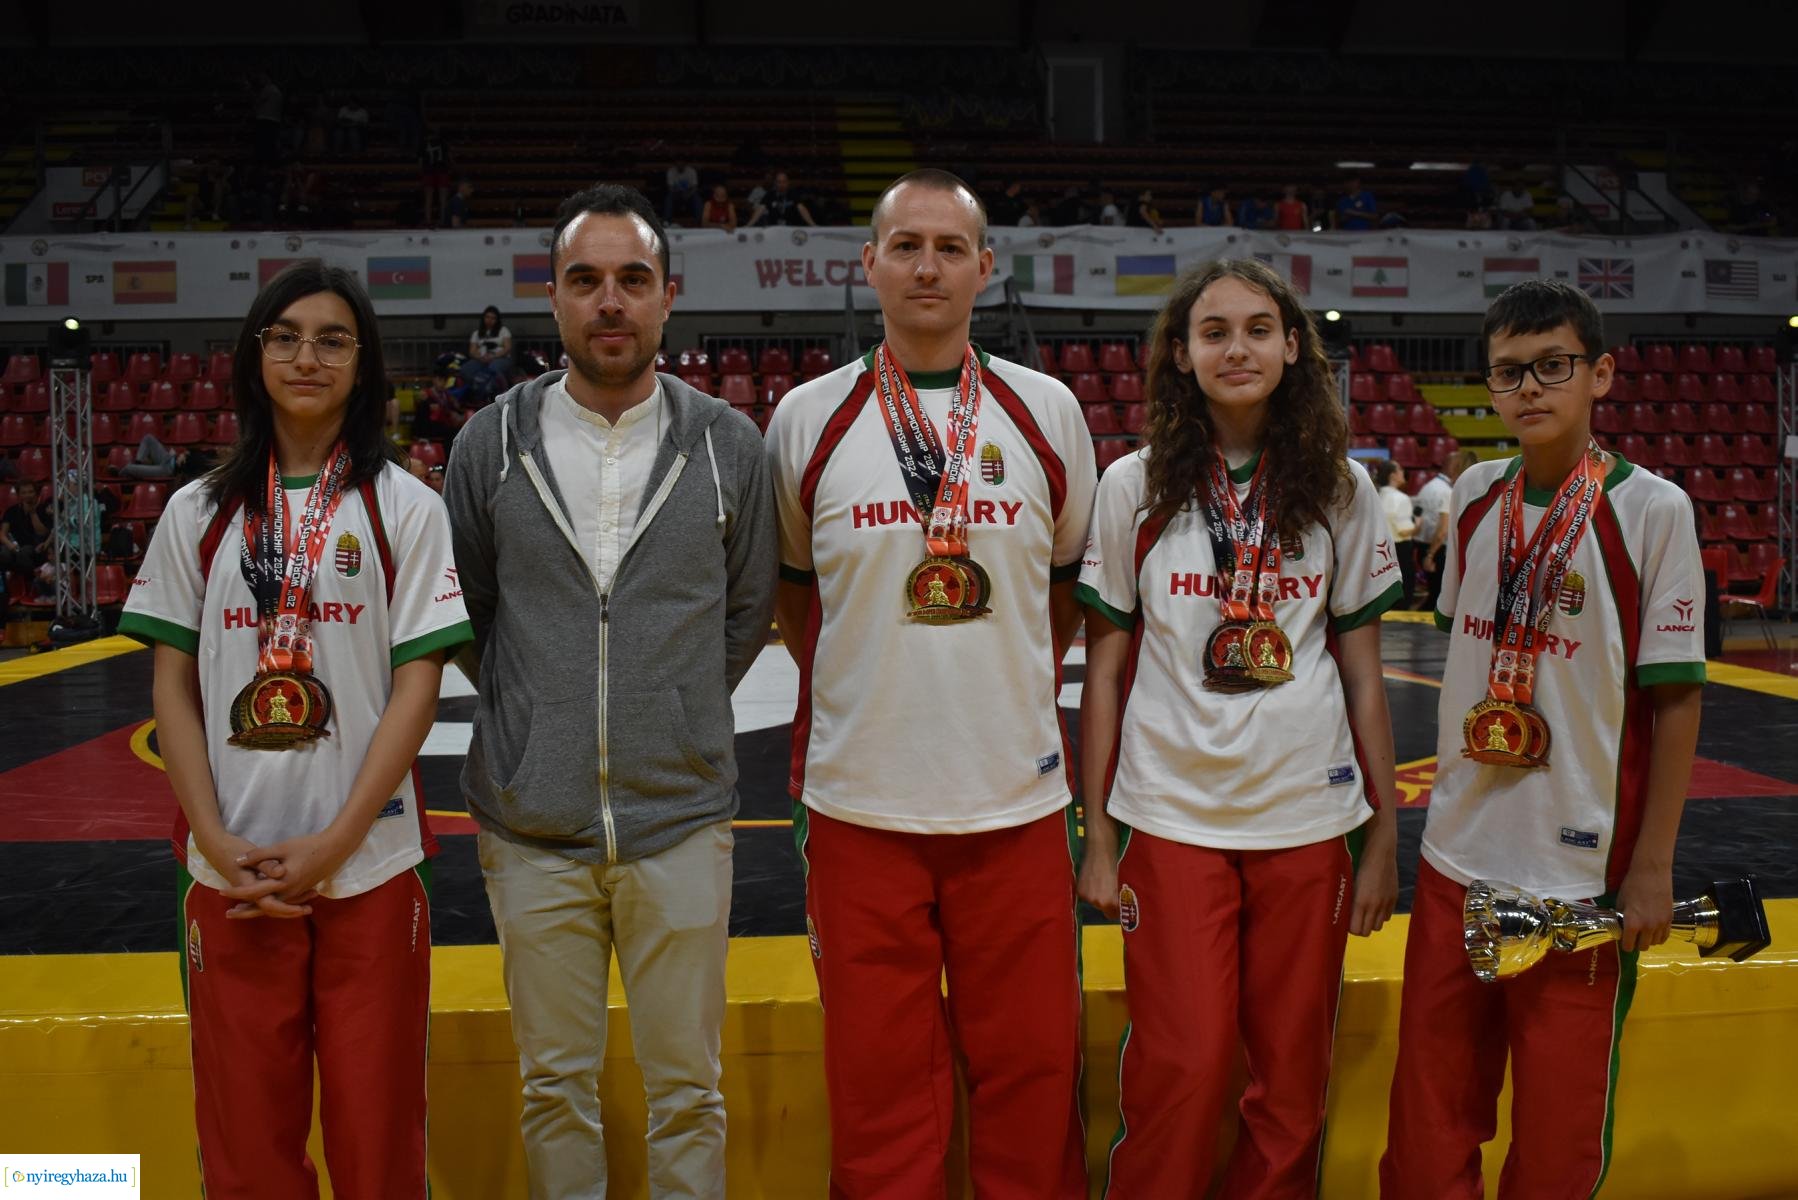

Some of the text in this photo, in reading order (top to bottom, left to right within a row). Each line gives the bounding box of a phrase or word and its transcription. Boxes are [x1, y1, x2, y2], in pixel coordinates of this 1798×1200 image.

[885, 394, 911, 454] CHAMPIONSHIP
[904, 455, 918, 477] 2024
[900, 391, 929, 452] CHAMPIONSHIP
[923, 453, 939, 476] 2024
[948, 453, 962, 483] WORLD
[1566, 473, 1586, 497] 2024
[852, 500, 1024, 530] HUNRY
[273, 556, 284, 581] 2024
[290, 554, 305, 588] WORLD
[1170, 572, 1323, 601] HURY
[223, 602, 365, 630] HUARY
[1463, 614, 1582, 660] HUNRY
